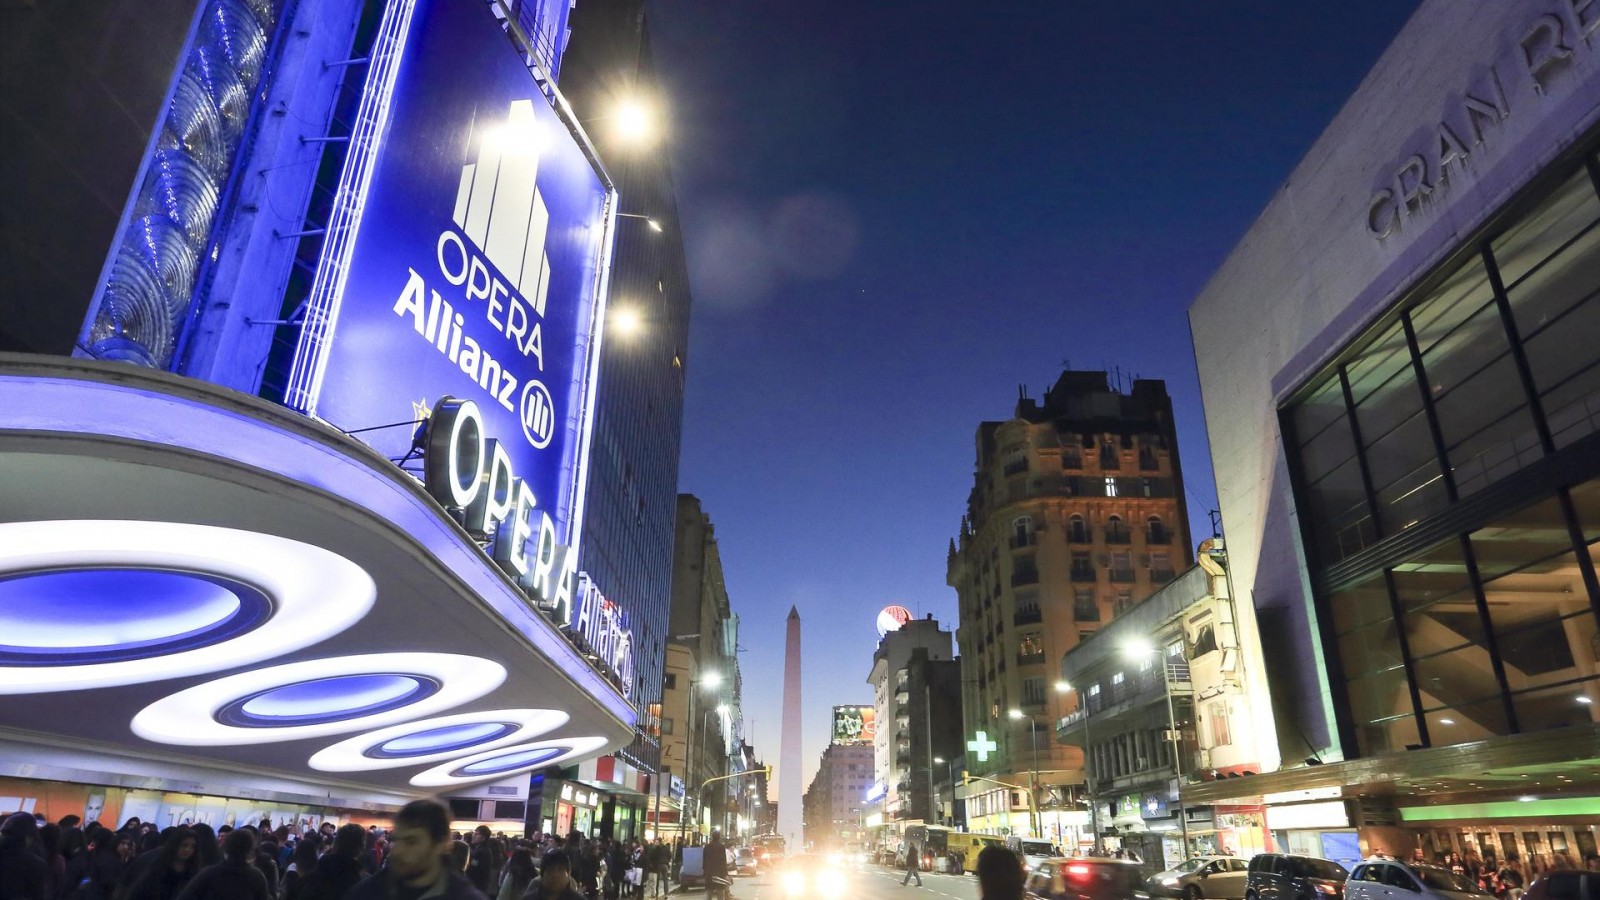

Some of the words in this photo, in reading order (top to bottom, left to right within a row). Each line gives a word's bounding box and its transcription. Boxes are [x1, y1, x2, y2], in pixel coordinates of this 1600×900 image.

[392, 266, 519, 413] Allianz
[437, 230, 543, 372] OPERA
[447, 398, 574, 626] OPERA
